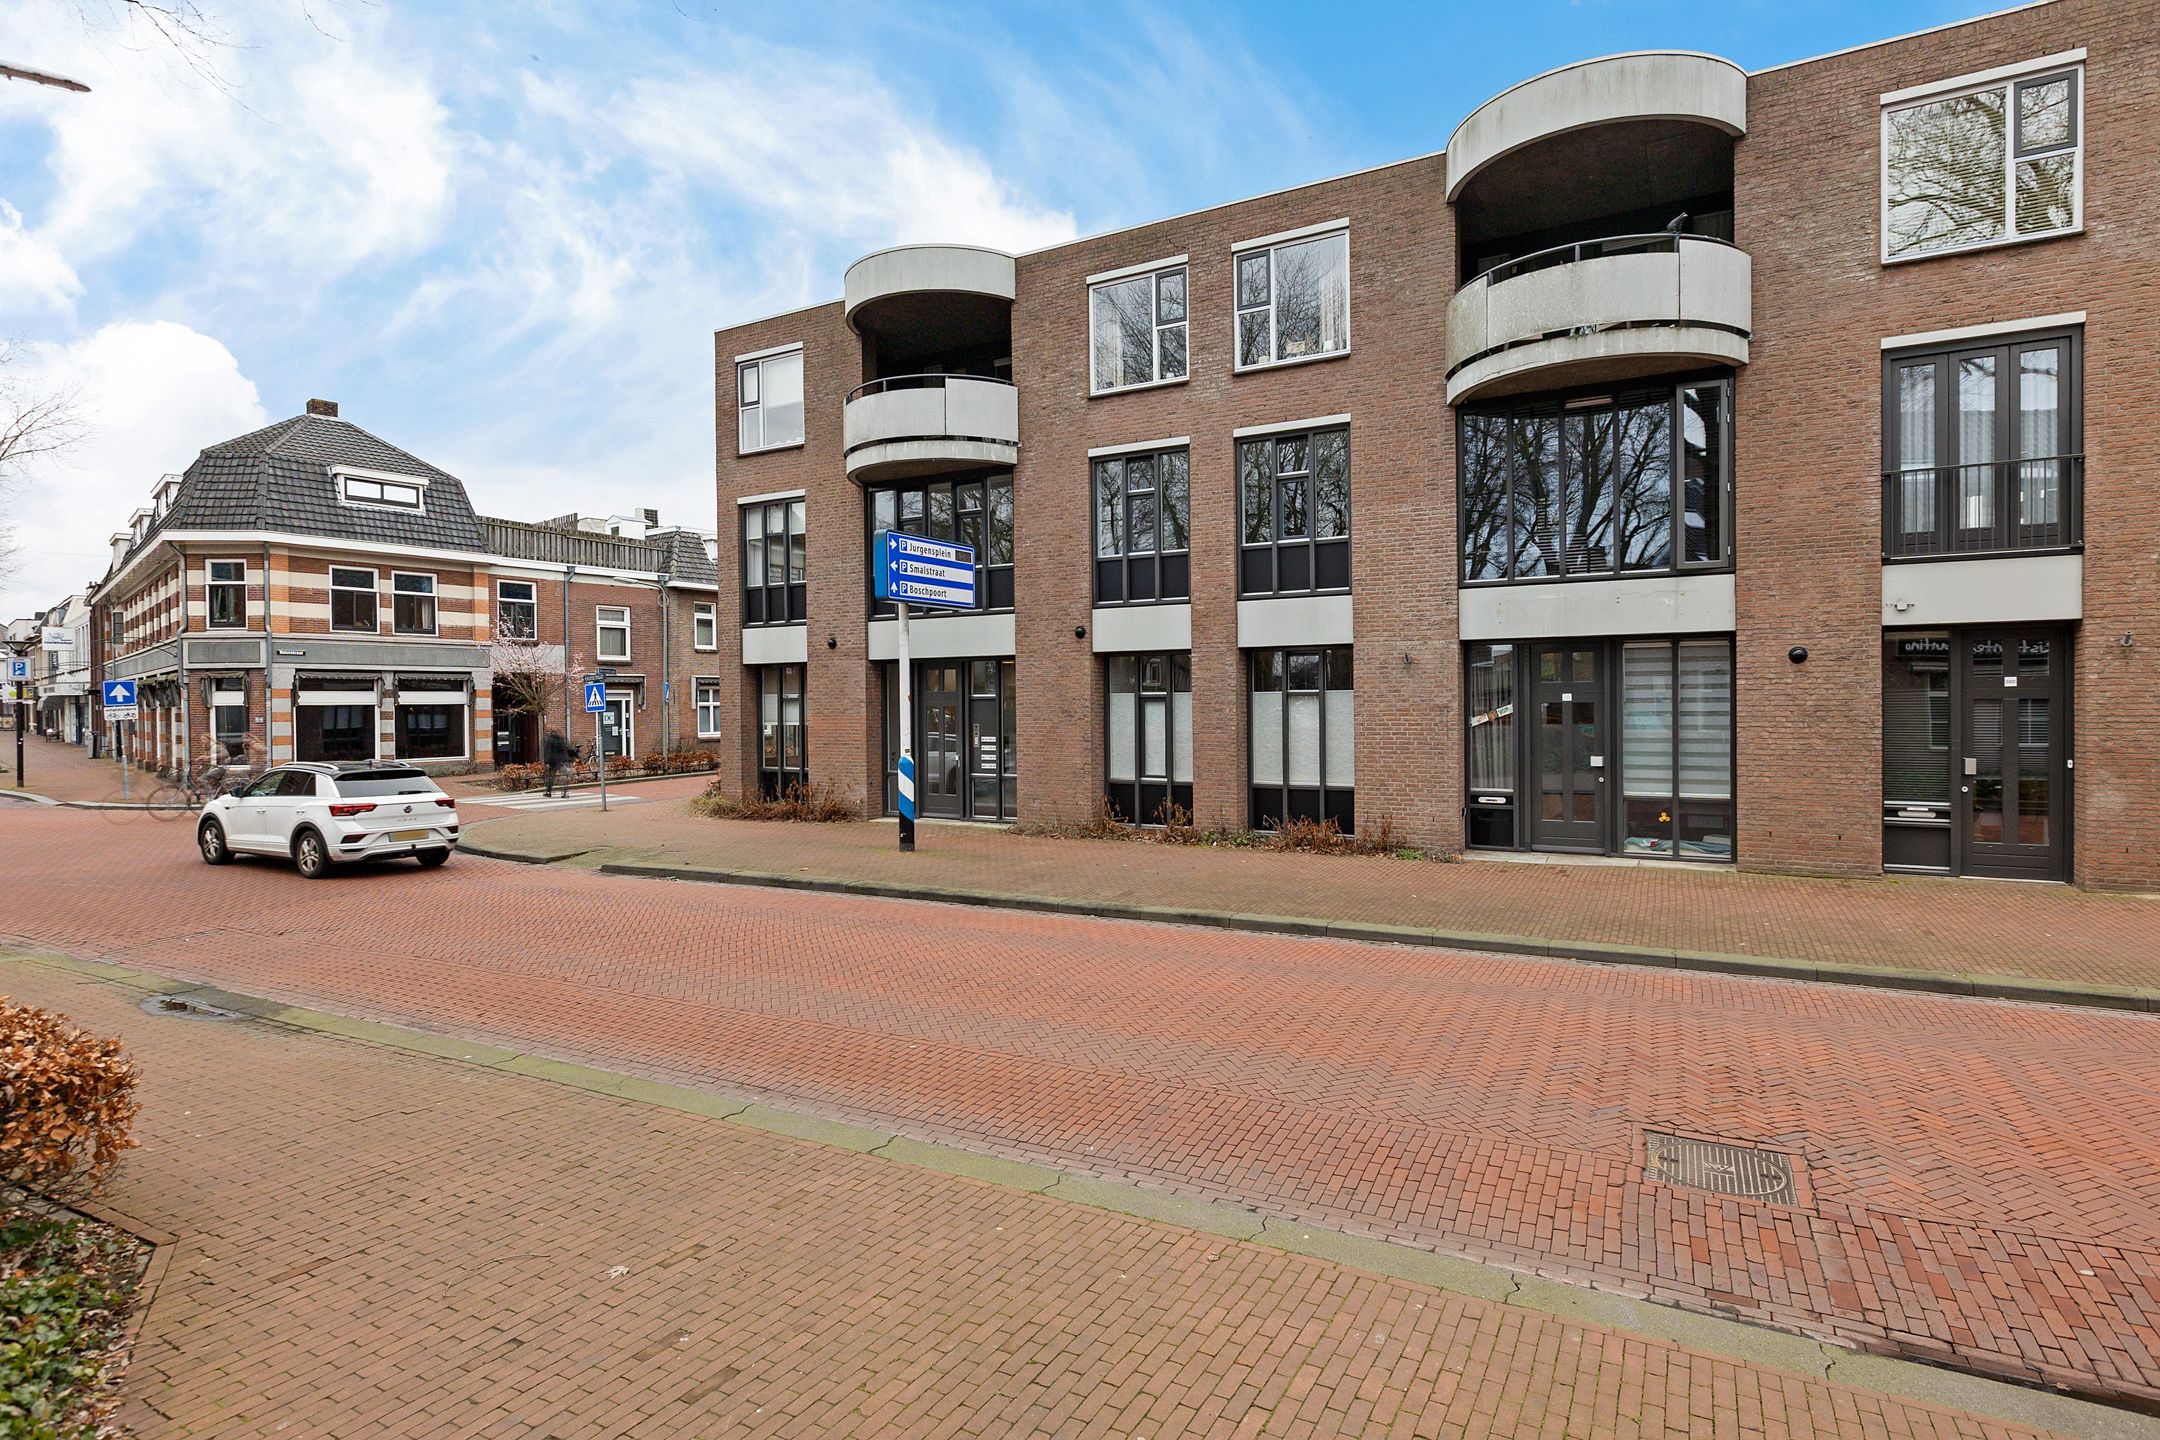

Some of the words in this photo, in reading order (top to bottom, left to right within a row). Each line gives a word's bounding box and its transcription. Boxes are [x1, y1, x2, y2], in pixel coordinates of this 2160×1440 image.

[909, 543, 951, 558] Jurgensplein
[909, 564, 945, 577] Smalstraat
[909, 585, 947, 599] Boschpoort
